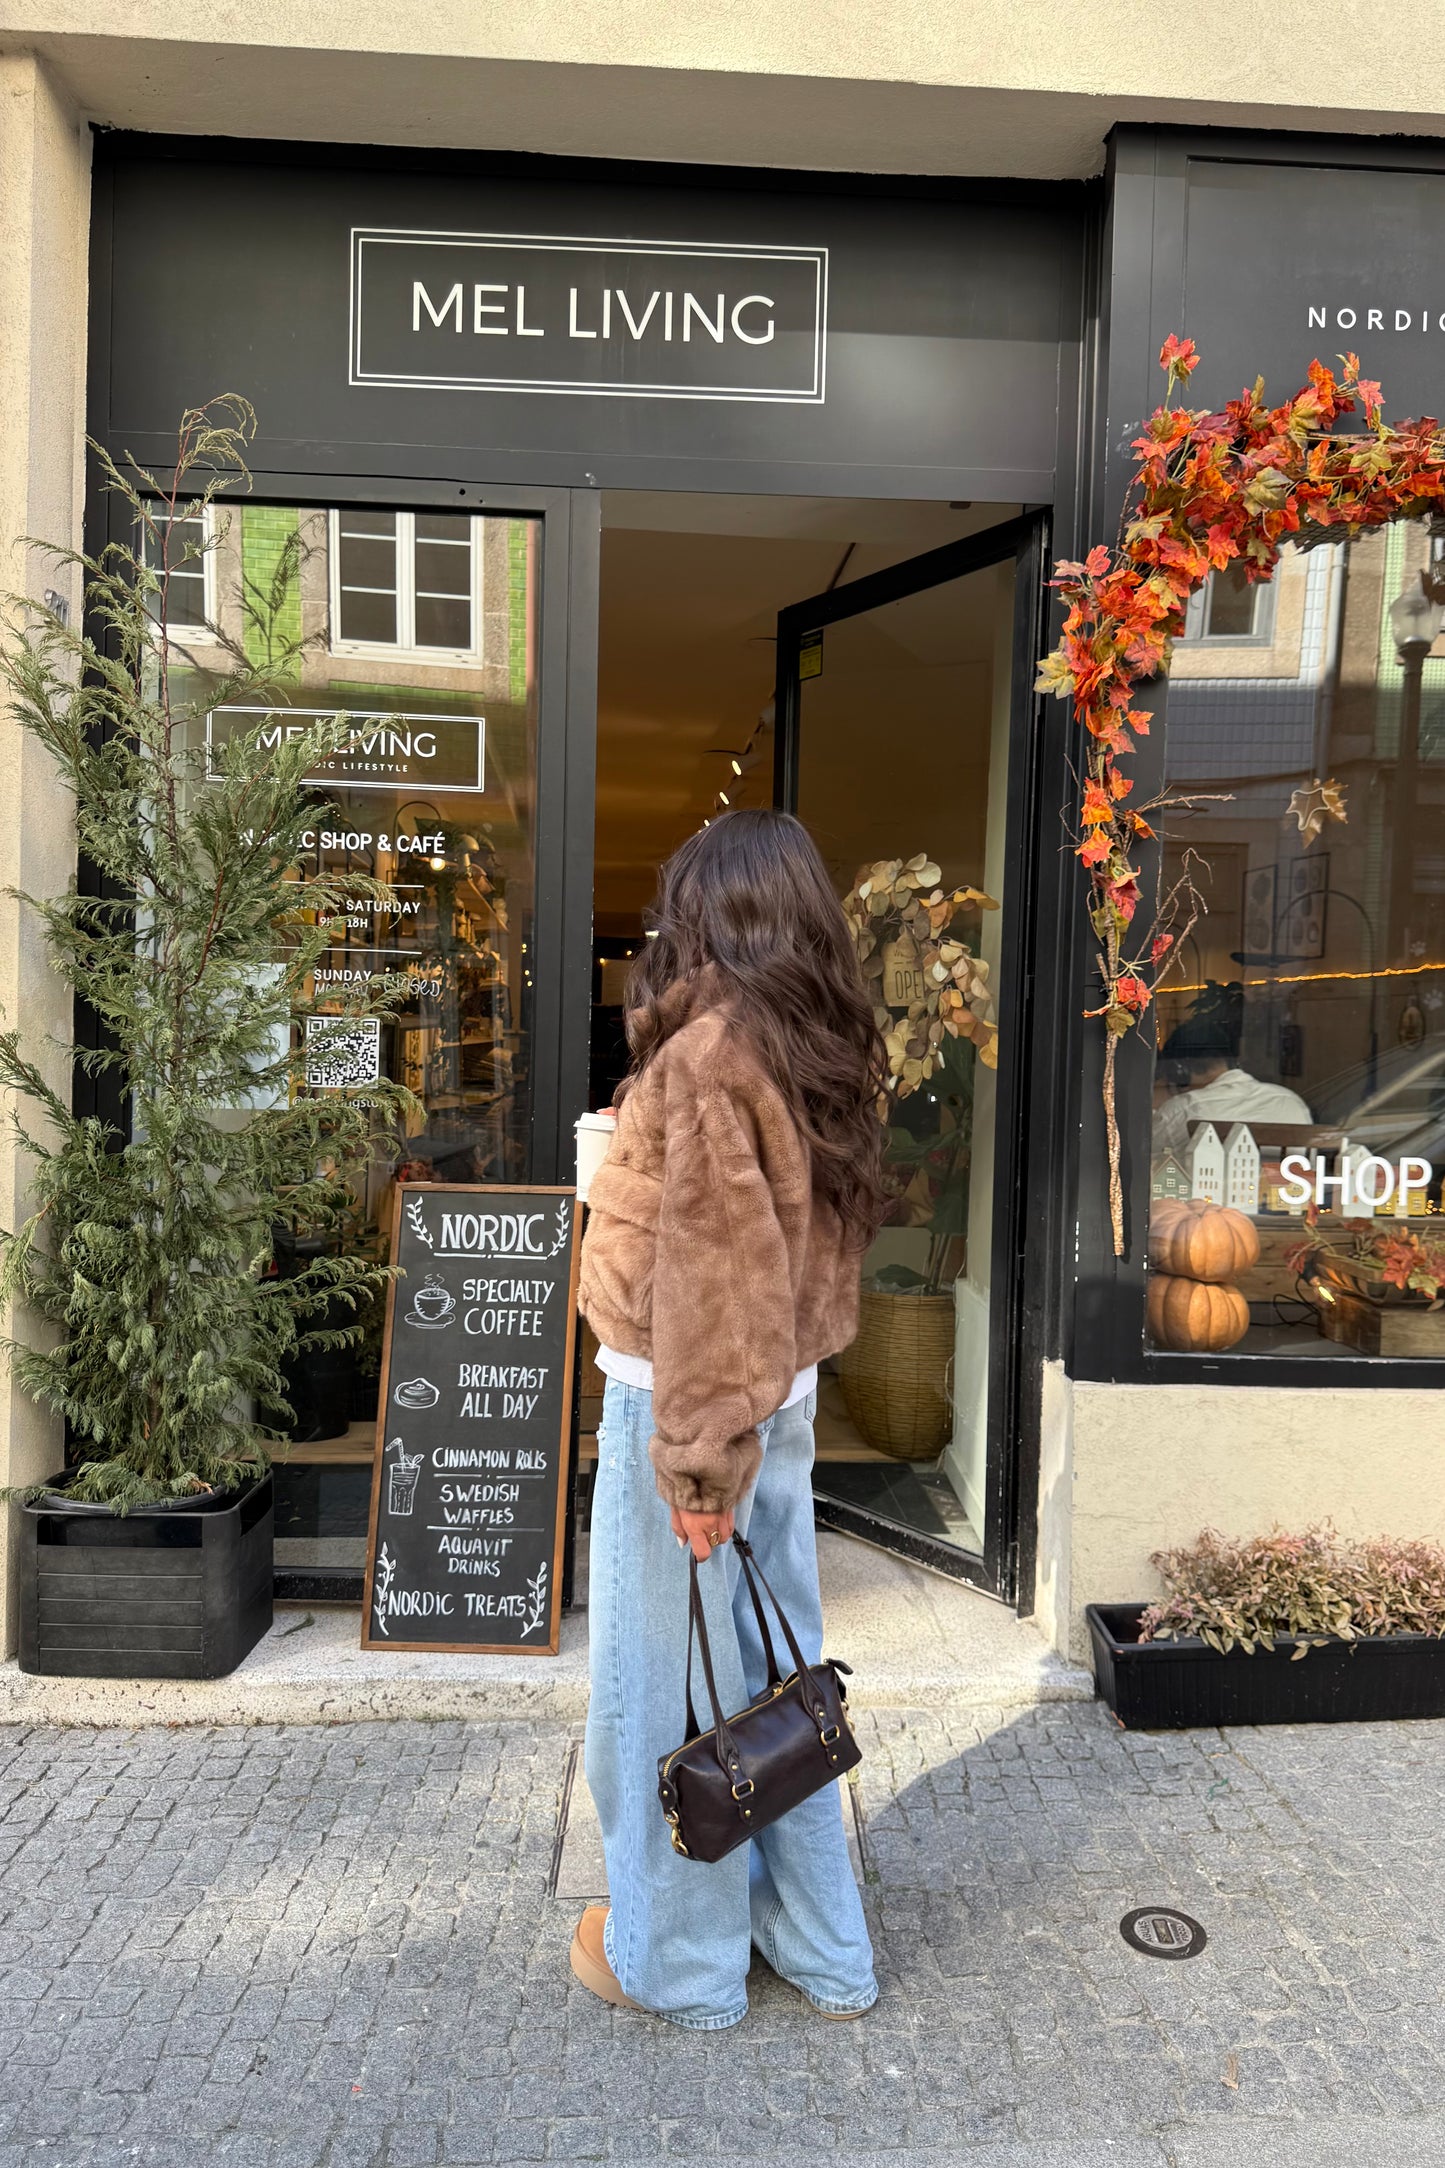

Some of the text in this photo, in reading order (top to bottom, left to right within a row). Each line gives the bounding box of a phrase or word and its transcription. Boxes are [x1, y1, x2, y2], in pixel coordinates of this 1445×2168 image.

[412, 281, 775, 345] MEL LIVING
[342, 762, 408, 773] LIFESTYLE
[320, 831, 372, 851] SHOP
[377, 834, 392, 852] &
[396, 831, 446, 854] CAFÉ
[346, 899, 421, 914] SATURDAY
[346, 917, 368, 929] 18H
[313, 968, 372, 982] SUNDAY
[1277, 1154, 1433, 1207] SHOP
[440, 1213, 546, 1253] NORDIC
[462, 1278, 555, 1304] SPECIALTY
[464, 1308, 544, 1336] COFFEE
[457, 1363, 549, 1389] BREAKFAST
[459, 1392, 539, 1421] ALL DAY
[515, 1449, 547, 1470] ROLLS
[443, 1507, 514, 1525] WAFFLES
[463, 1592, 527, 1618] TREATS
